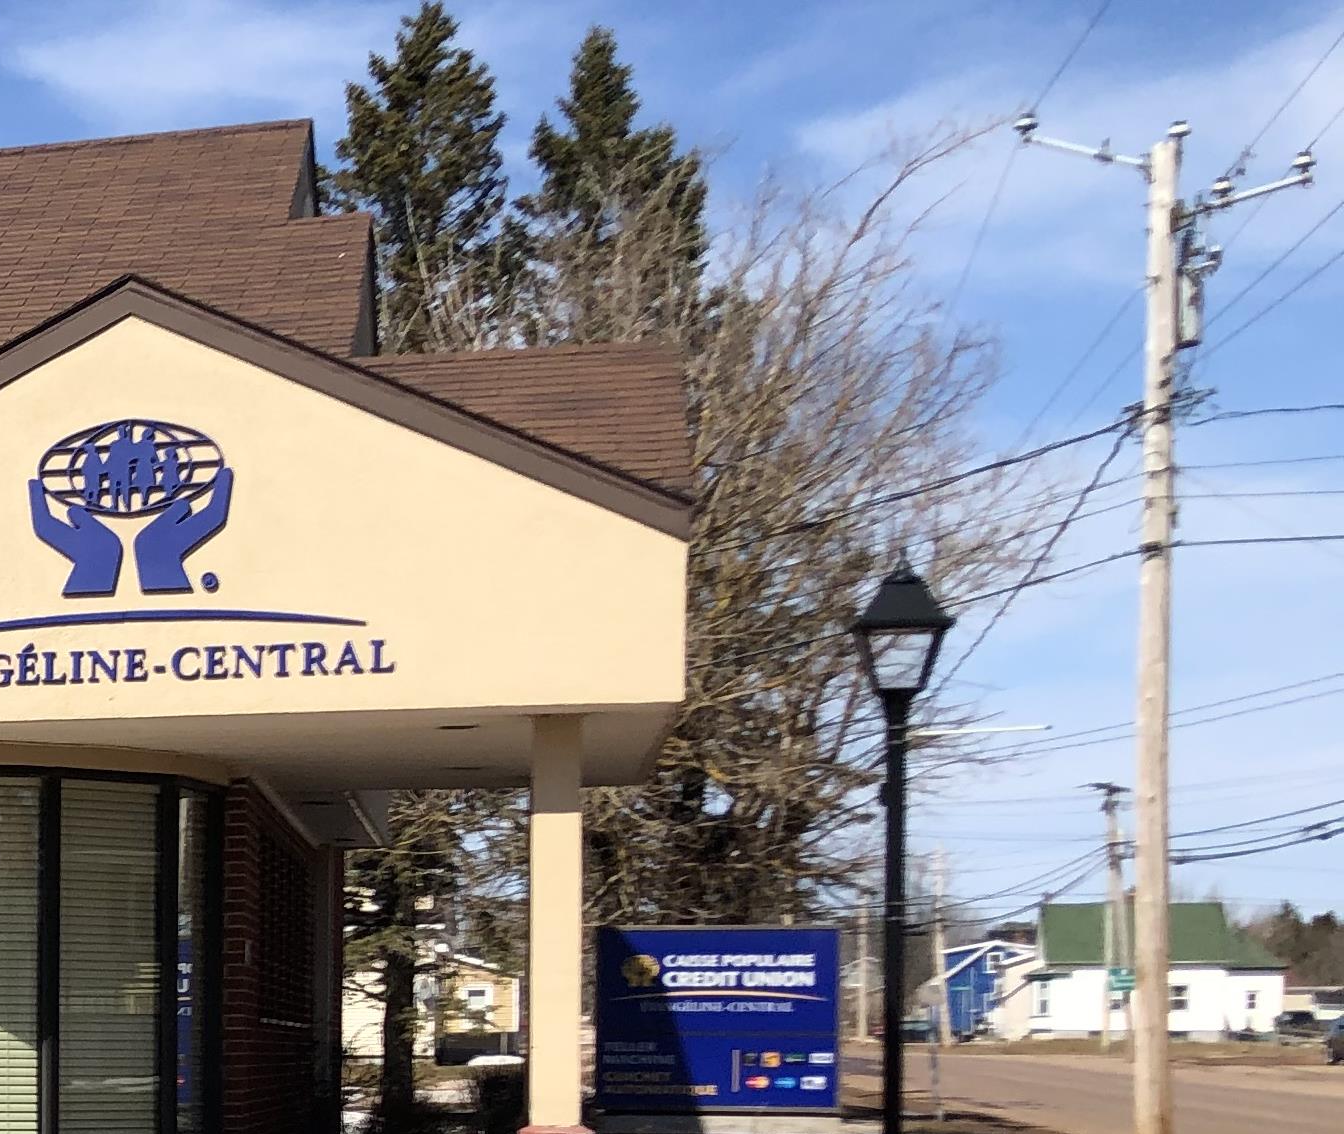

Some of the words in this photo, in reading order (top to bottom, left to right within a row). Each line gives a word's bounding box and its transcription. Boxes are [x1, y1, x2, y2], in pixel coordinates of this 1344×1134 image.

[662, 954, 720, 967] CAISSE
[721, 953, 816, 967] POPULAIRE
[662, 970, 740, 987] CREDIT
[741, 970, 817, 987] UNION
